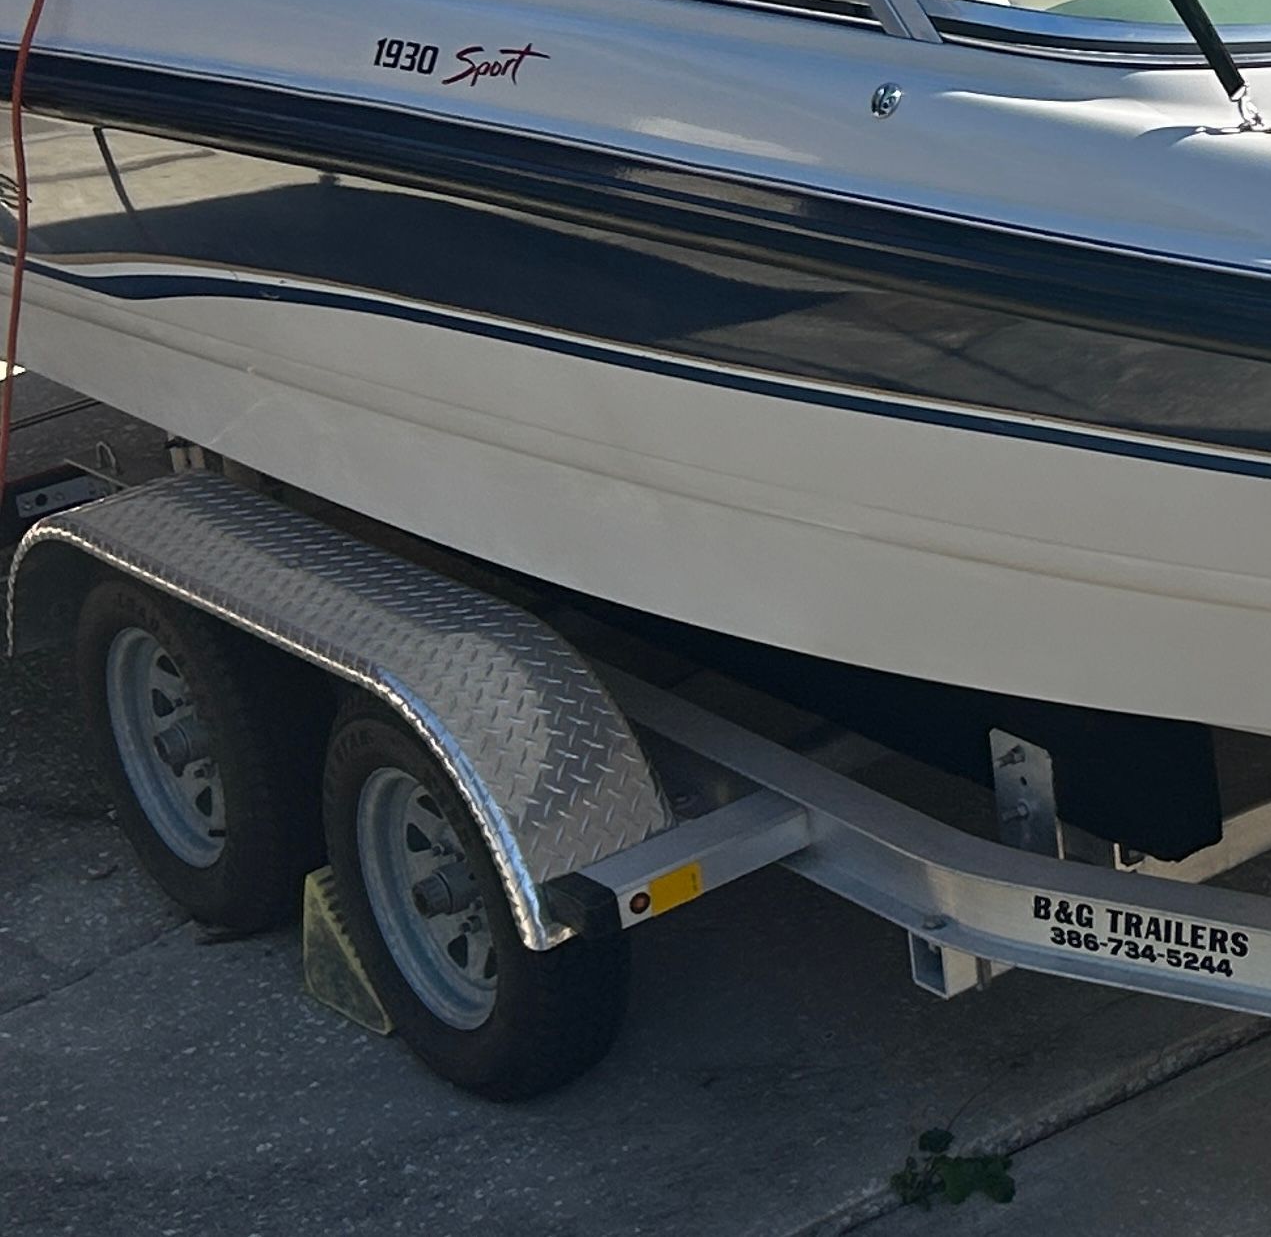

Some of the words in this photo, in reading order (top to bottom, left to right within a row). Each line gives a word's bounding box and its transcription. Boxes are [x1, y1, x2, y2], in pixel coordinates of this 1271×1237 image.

[373, 38, 440, 75] 1930
[441, 42, 552, 87] Sport
[1033, 895, 1095, 929] B&G
[1105, 907, 1250, 958] TRAILERS
[1050, 926, 1234, 978] 386-734-5244
